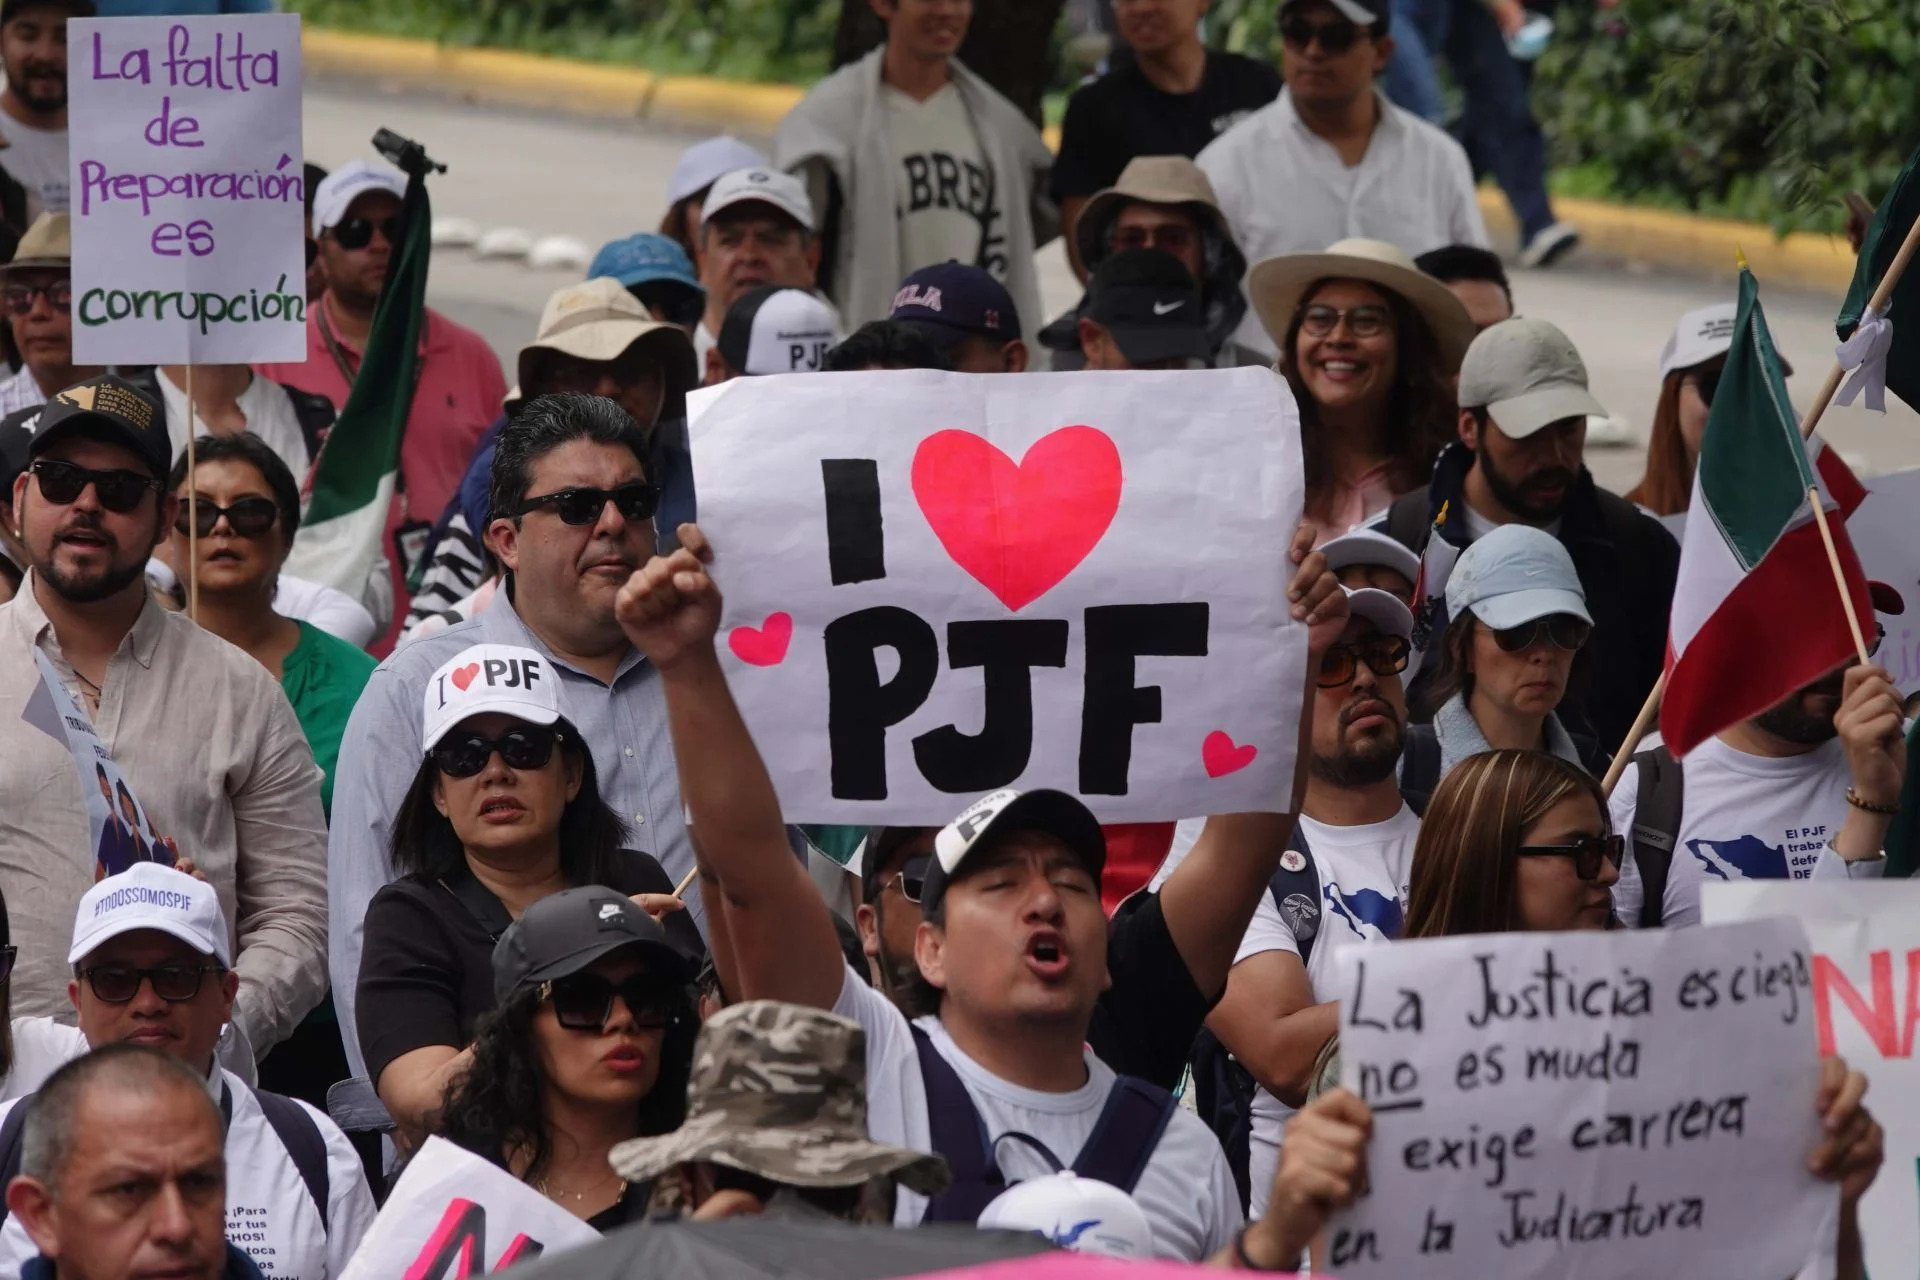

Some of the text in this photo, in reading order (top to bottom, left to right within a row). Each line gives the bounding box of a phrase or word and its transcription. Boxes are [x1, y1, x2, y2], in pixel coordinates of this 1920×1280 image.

[93, 24, 278, 92] La falta
[144, 96, 204, 147] de
[79, 153, 303, 216] Preparación
[151, 219, 214, 257] es
[78, 273, 306, 336] corrupción
[821, 458, 887, 586] I
[437, 659, 541, 711] I PJF
[822, 602, 1209, 800] PJF
[1785, 825, 1826, 839] El PJF
[1788, 839, 1826, 852] traba
[94, 887, 191, 918] #TODOSSOMOSPJF
[1349, 961, 1424, 1033] La
[1467, 950, 1652, 1028] Justicia
[1359, 1033, 1641, 1101] no es muda
[1403, 1094, 1750, 1188] exige carrera
[233, 1207, 267, 1218] ¡Para
[245, 1220, 267, 1229] tus
[1330, 1230, 1382, 1269] en
[1419, 1207, 1456, 1254] la
